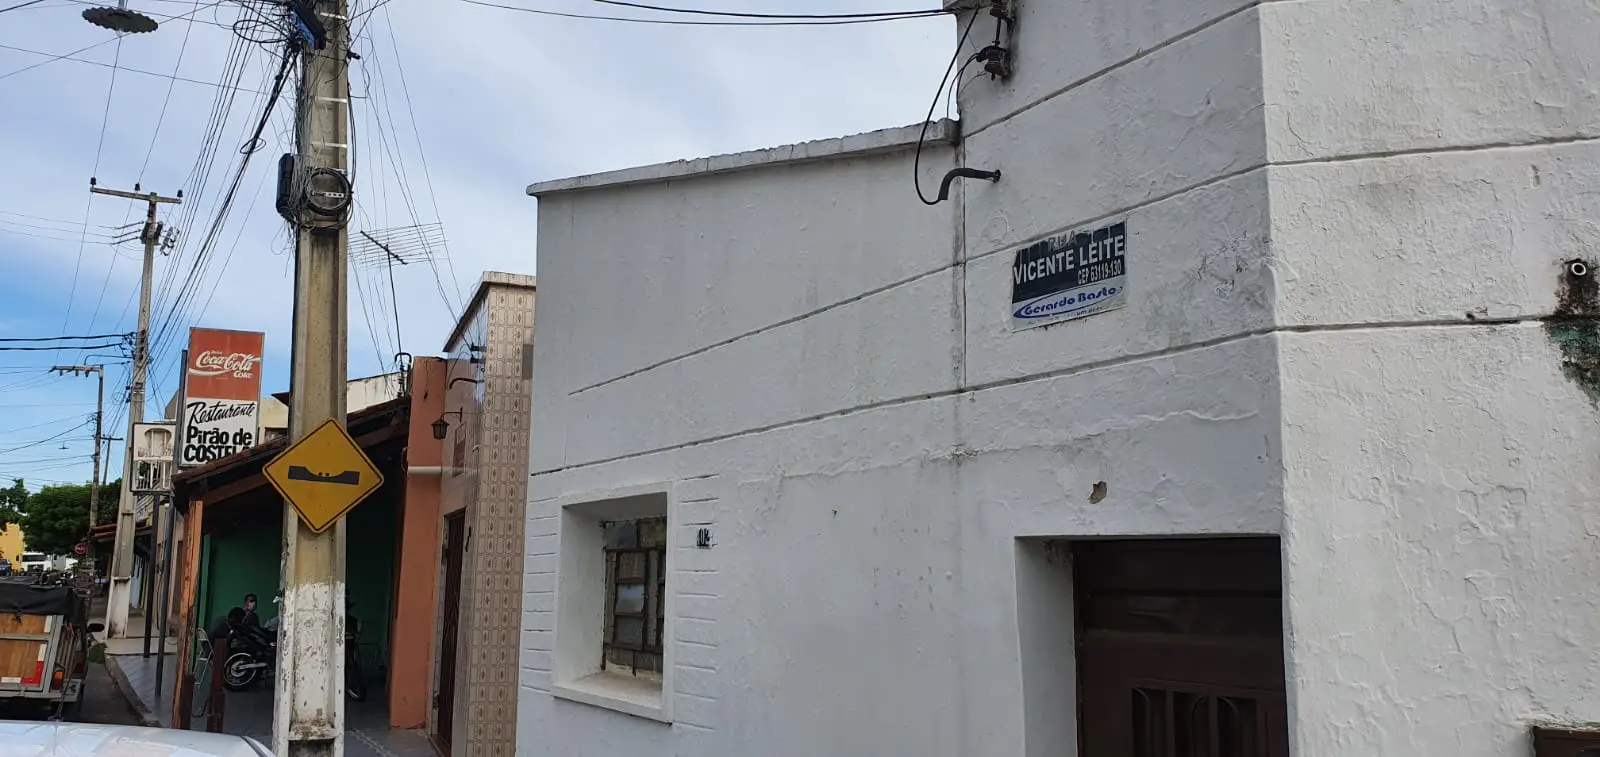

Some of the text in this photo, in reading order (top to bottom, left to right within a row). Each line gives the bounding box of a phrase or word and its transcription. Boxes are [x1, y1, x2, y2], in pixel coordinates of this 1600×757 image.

[1048, 231, 1077, 251] RUA
[1014, 235, 1124, 285] VICENTE LEITE
[1078, 259, 1122, 285] CEP 63119-130
[1024, 297, 1076, 316] Gerardo
[1078, 286, 1122, 302] Basto
[187, 401, 256, 426] Restaurante
[186, 425, 253, 446] Pirão de
